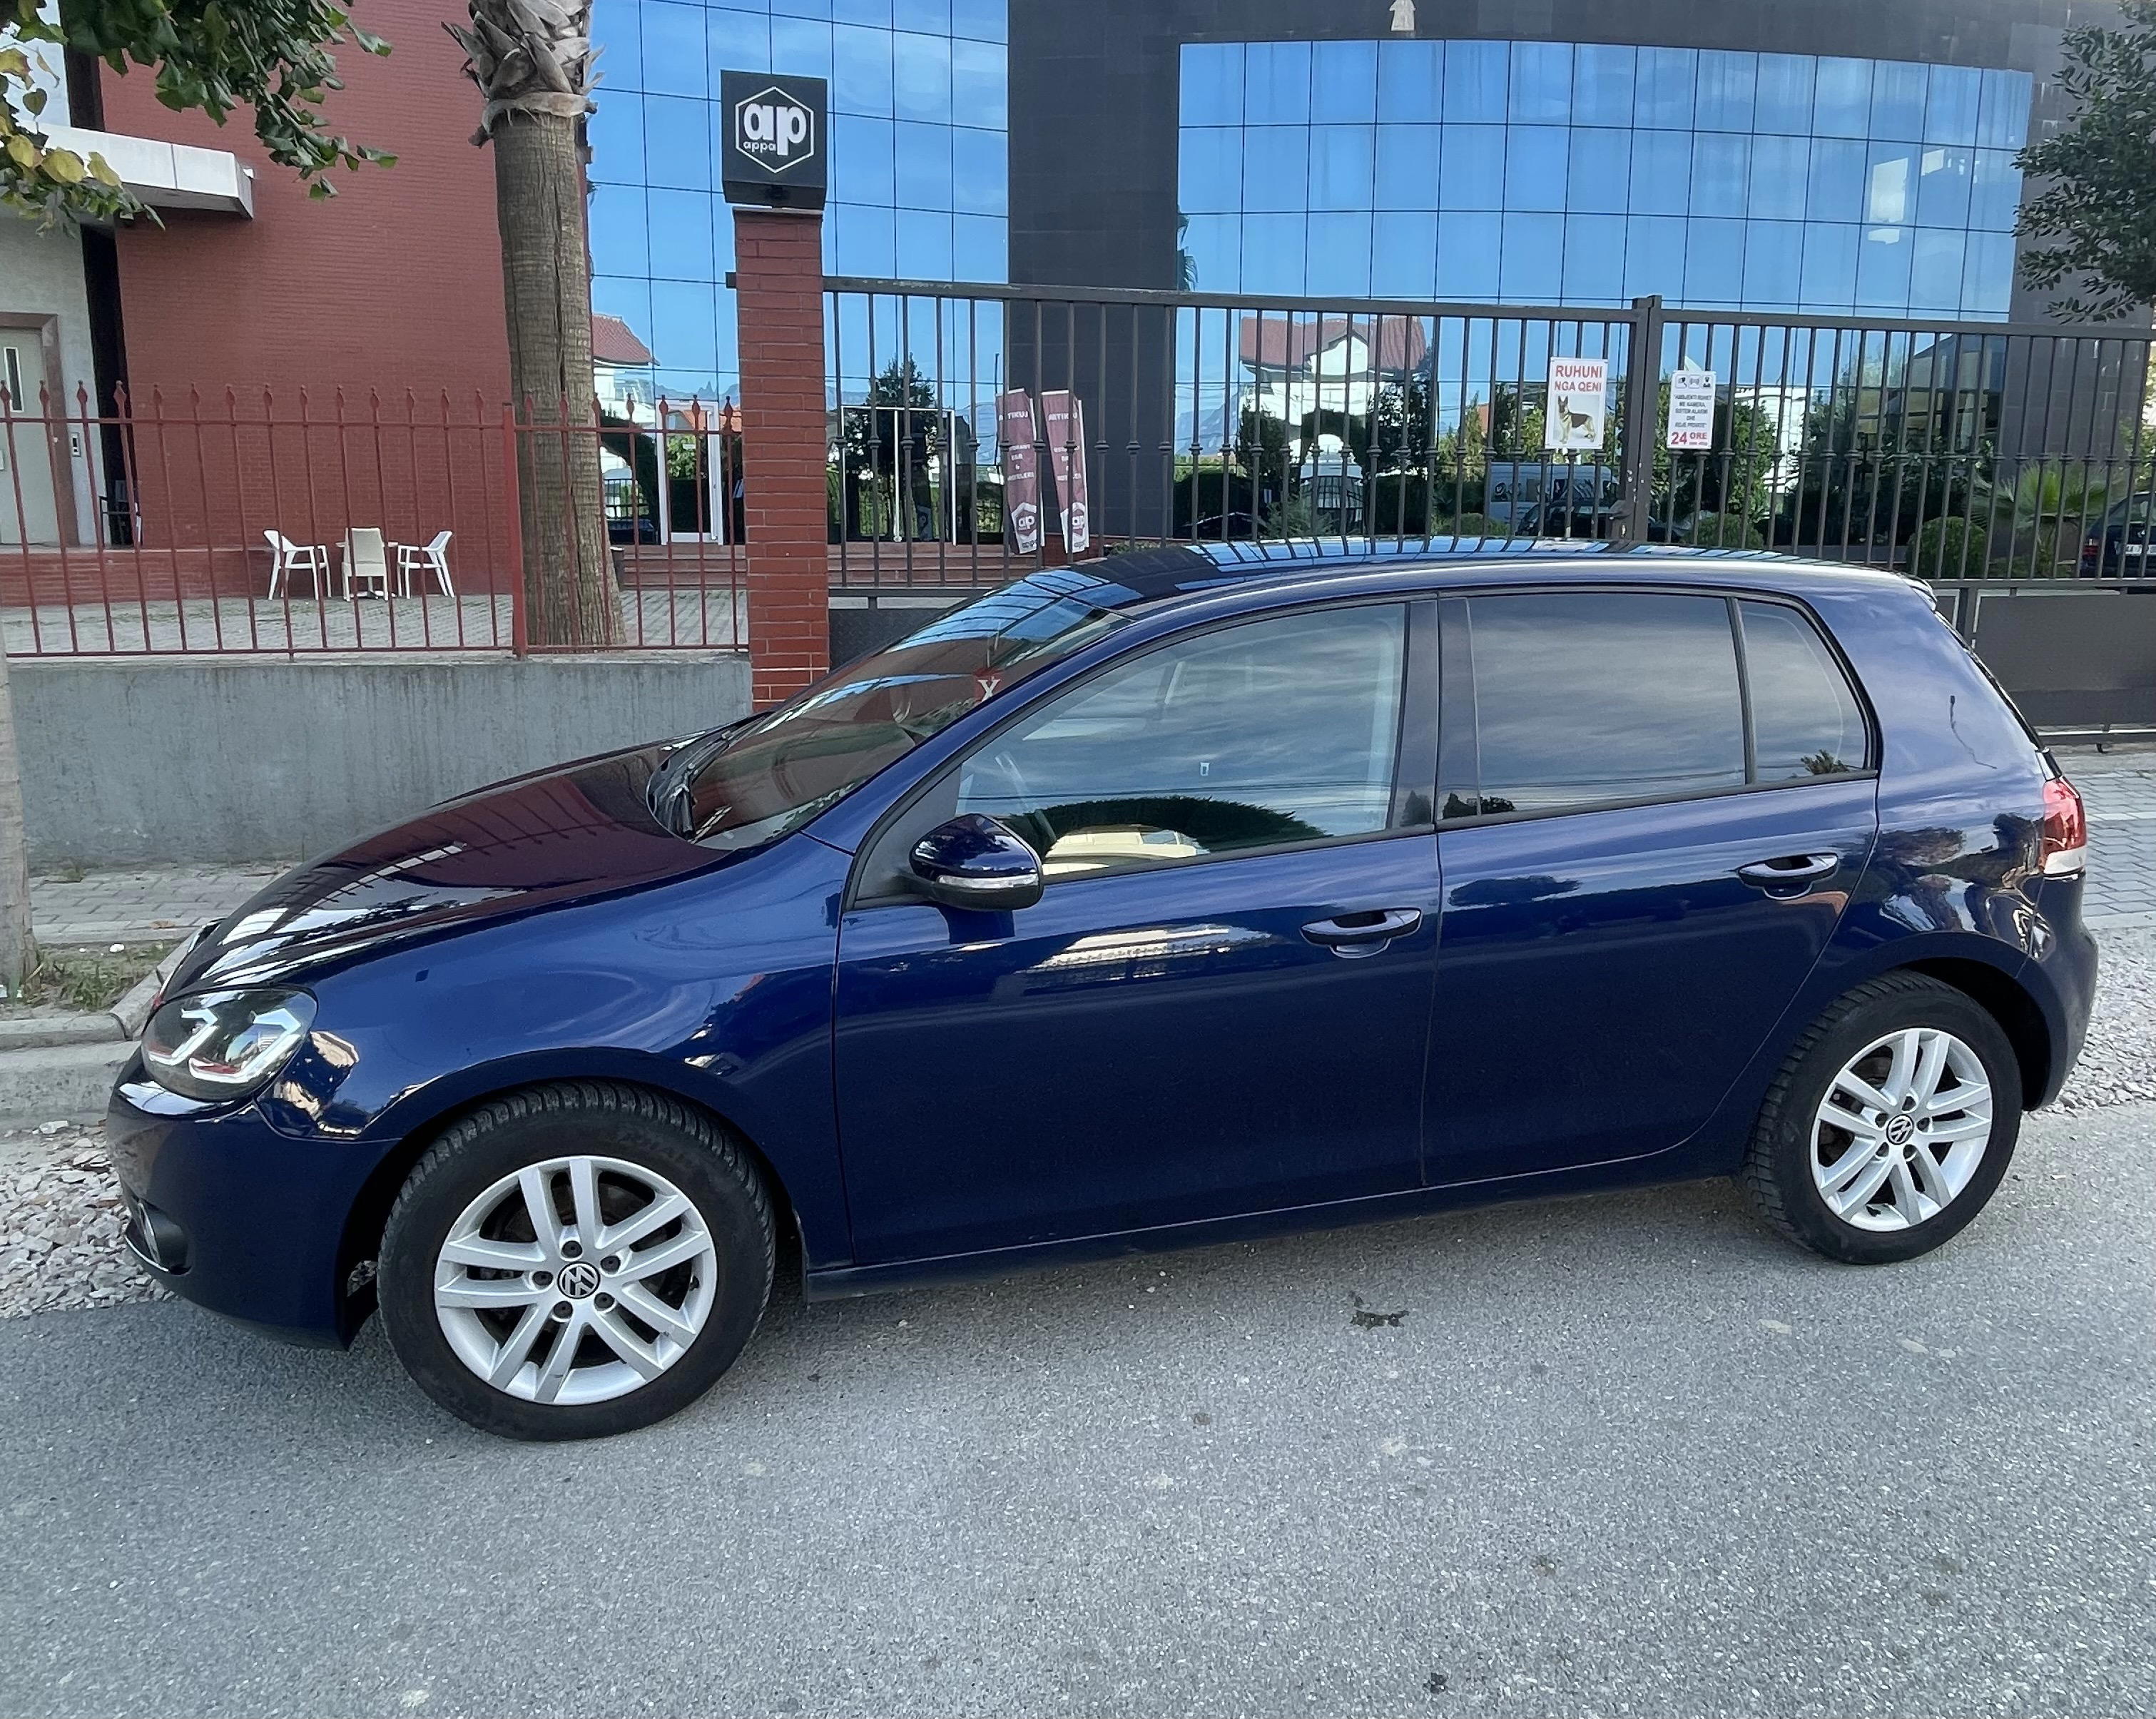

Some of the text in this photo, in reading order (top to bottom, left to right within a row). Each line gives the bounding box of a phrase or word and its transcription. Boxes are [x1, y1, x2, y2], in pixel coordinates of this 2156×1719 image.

[743, 103, 807, 156] ap
[743, 141, 776, 153] appa
[1555, 365, 1602, 378] RUHUNI
[1555, 381, 1602, 392] NGA QENI
[999, 411, 1029, 422] ATIKUJ
[1670, 431, 1707, 445] 24 ORE
